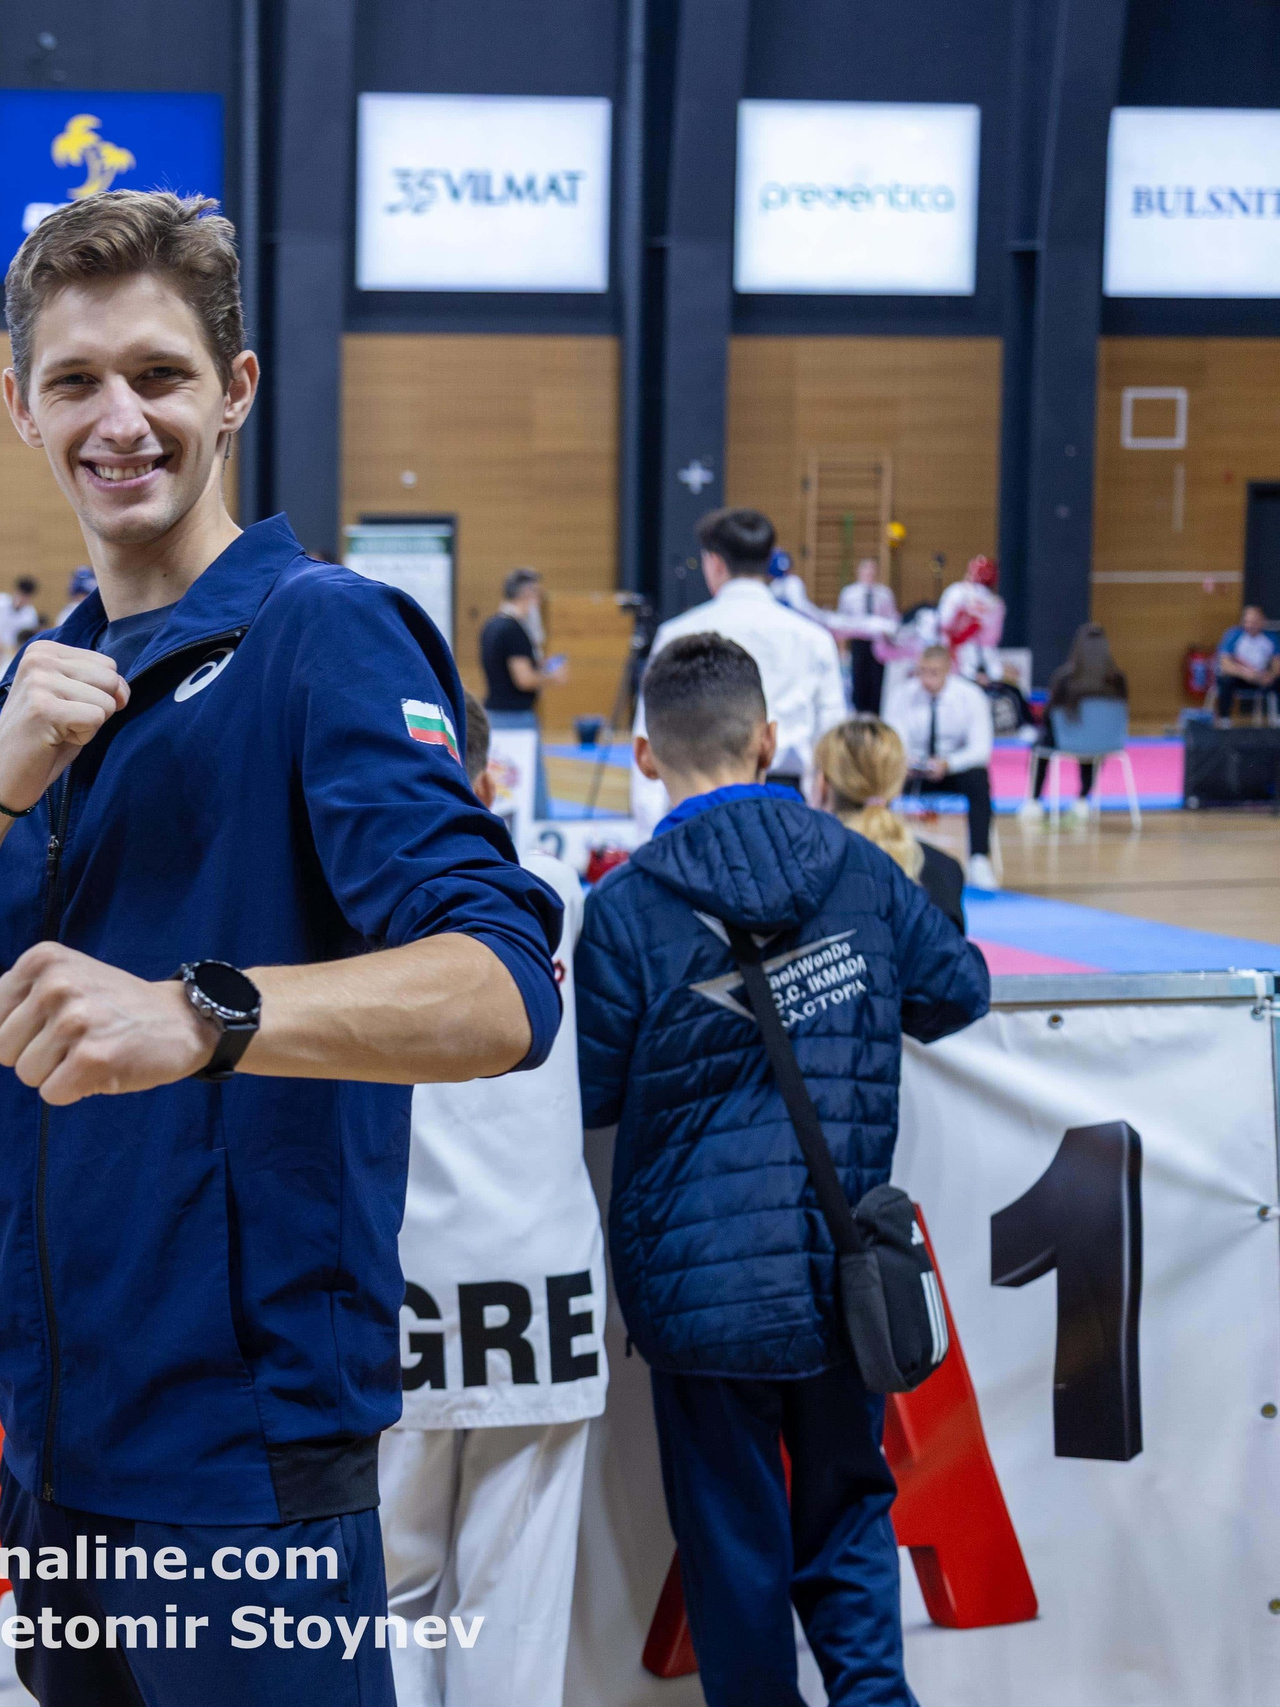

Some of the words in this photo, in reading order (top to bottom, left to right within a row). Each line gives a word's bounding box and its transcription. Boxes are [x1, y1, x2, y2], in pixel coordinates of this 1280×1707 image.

[443, 168, 586, 207] VILMAT
[400, 1269, 600, 1391] GRE
[990, 1119, 1145, 1463] 1
